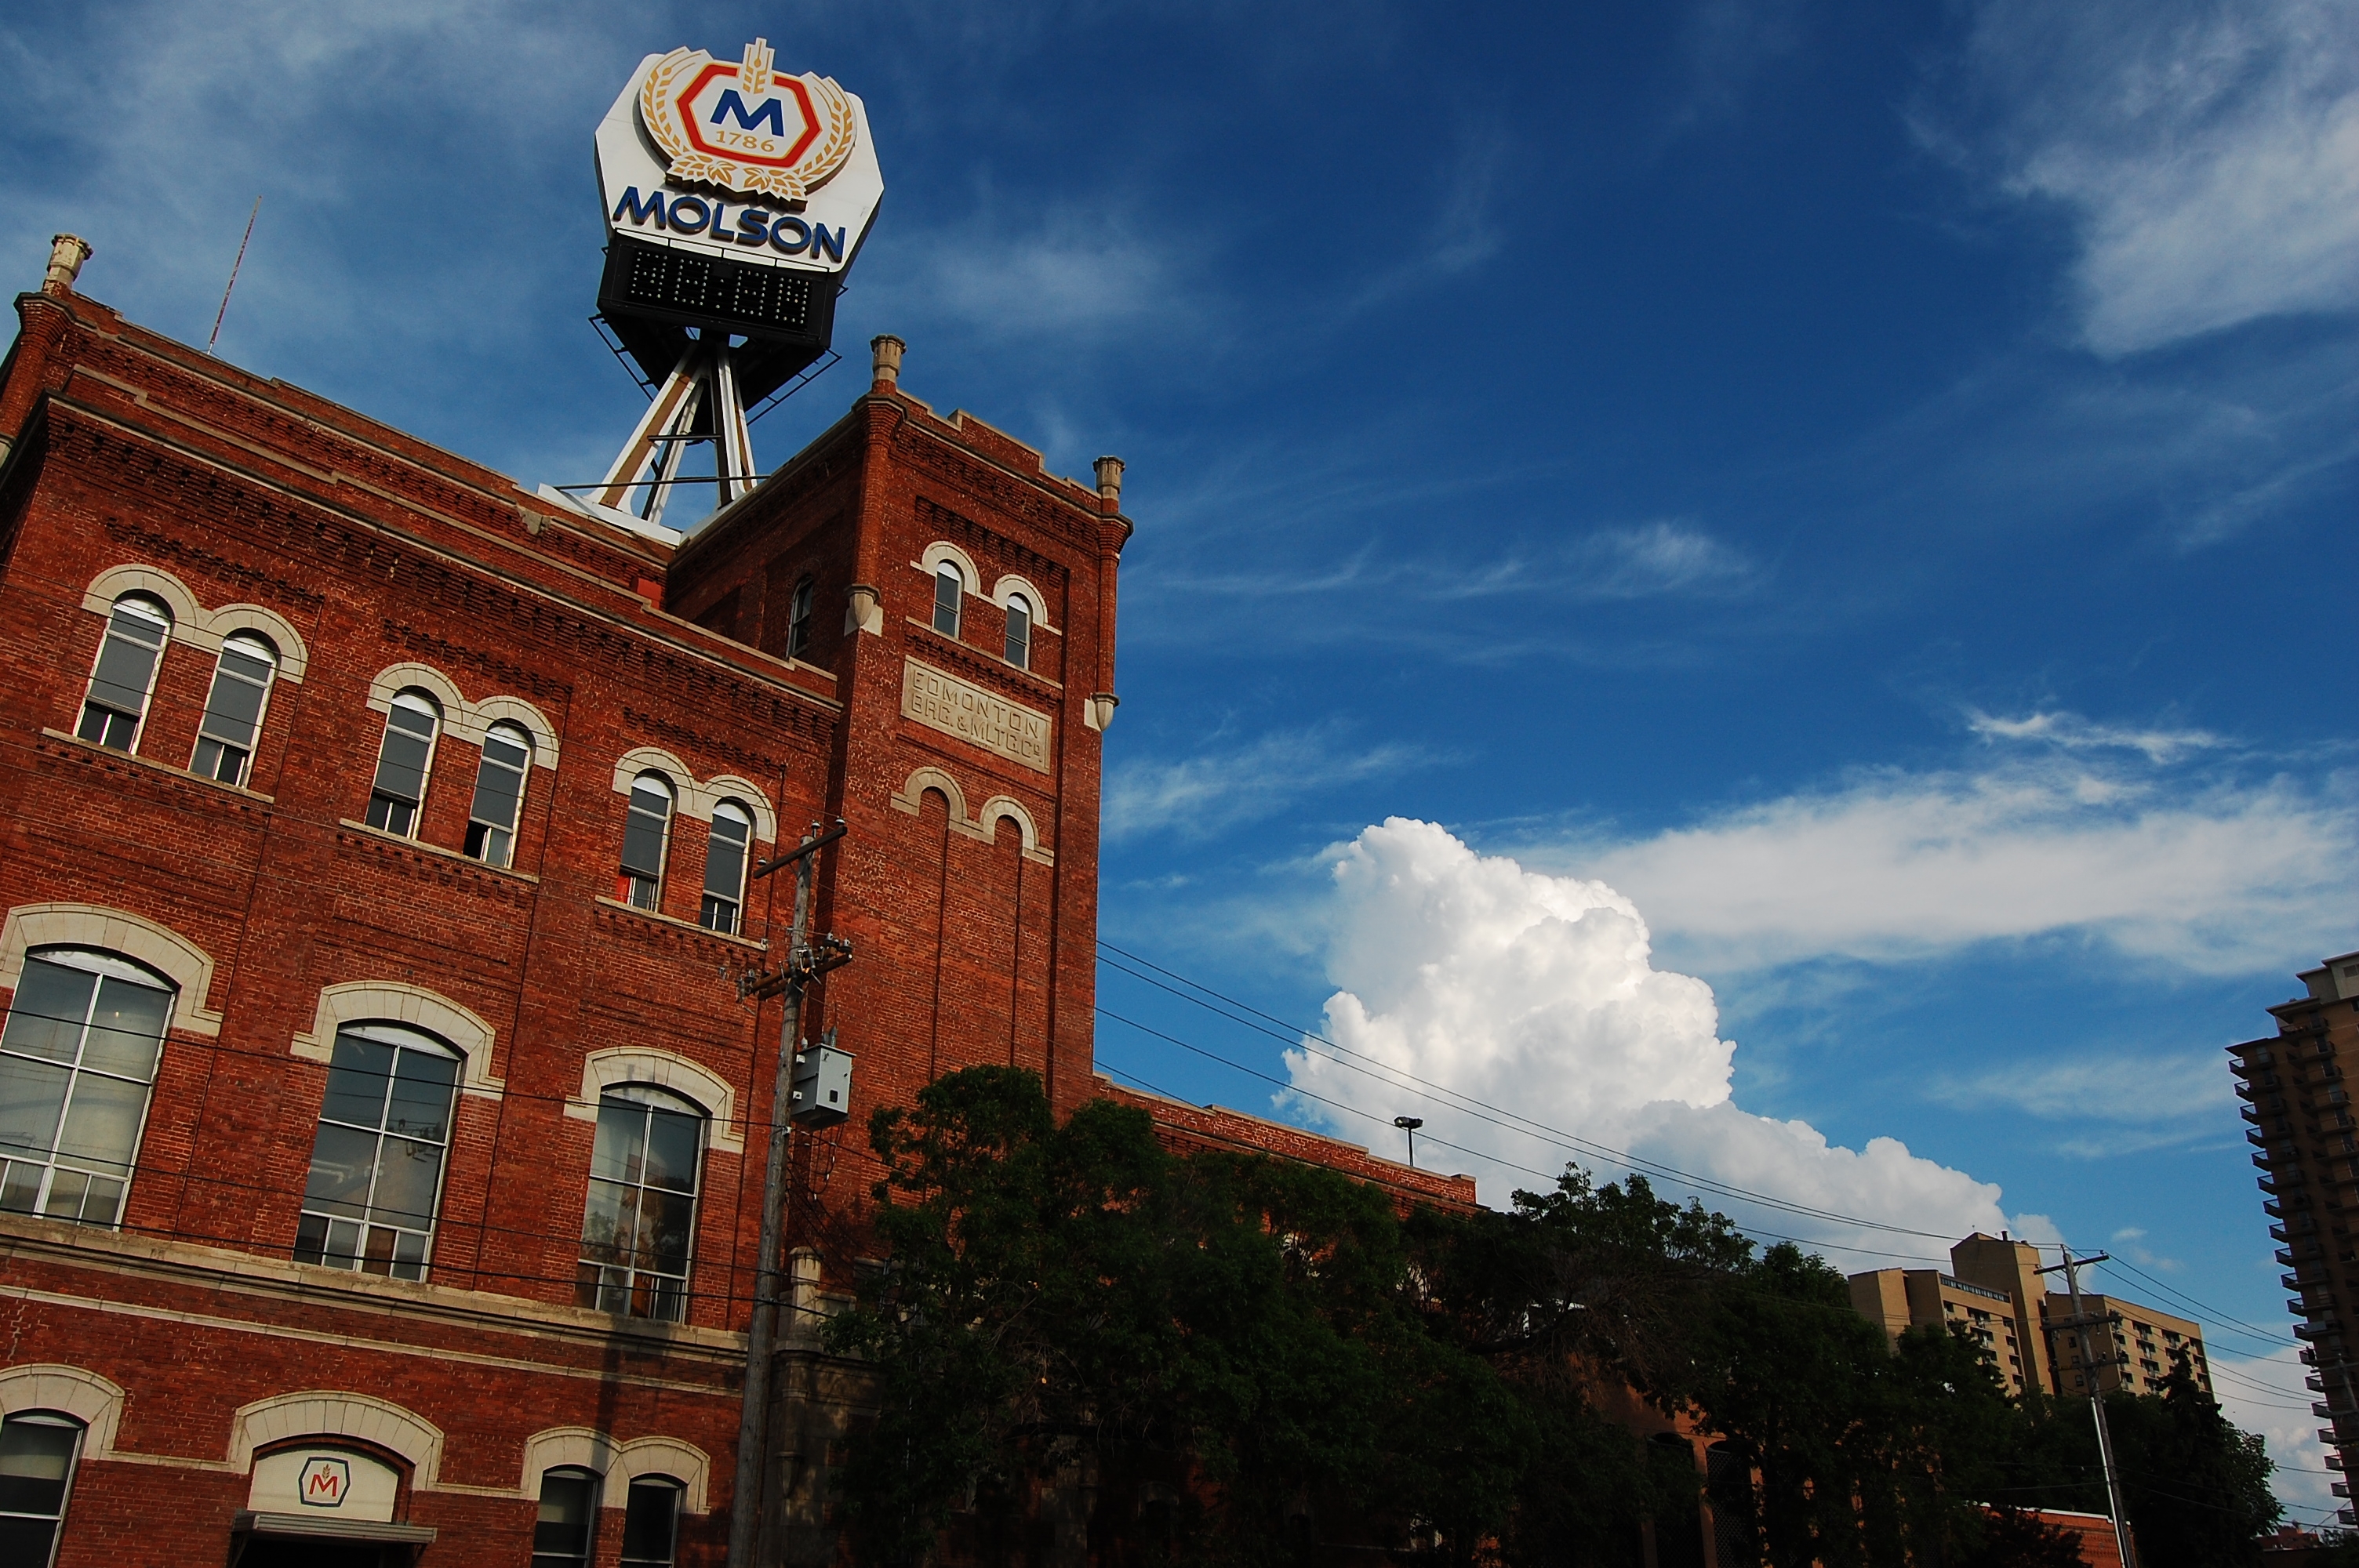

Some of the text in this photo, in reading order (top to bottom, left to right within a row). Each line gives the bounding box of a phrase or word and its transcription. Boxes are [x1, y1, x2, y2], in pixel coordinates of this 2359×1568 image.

[709, 88, 784, 137] M
[715, 130, 775, 152] 1786
[612, 185, 846, 263] MOLSON
[911, 692, 954, 728] BRG.
[957, 715, 969, 733] &
[913, 669, 1038, 739] EDMONTON
[308, 1474, 338, 1497] M
